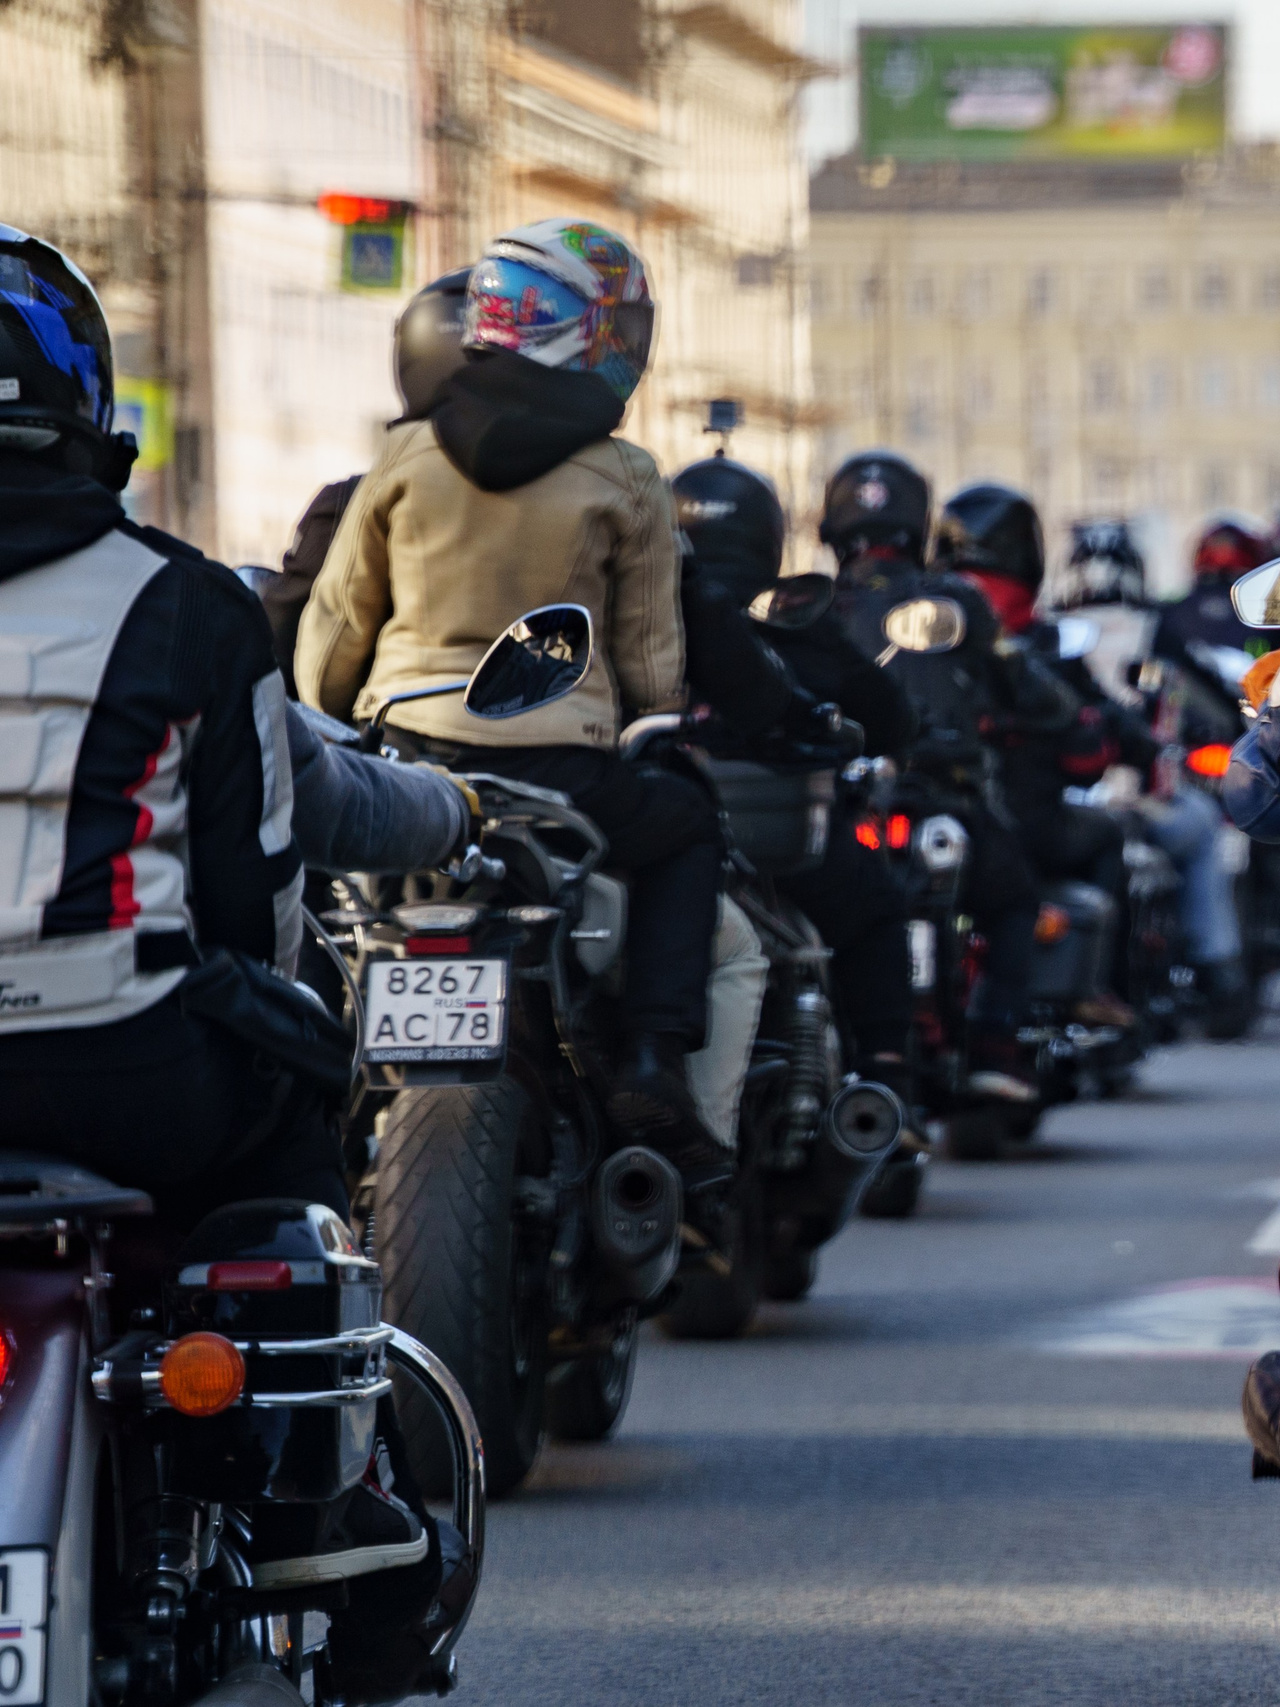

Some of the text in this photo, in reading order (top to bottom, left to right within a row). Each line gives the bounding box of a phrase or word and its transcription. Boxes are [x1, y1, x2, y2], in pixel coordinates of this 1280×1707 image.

[387, 965, 485, 995] 8267
[434, 998, 463, 1008] RUS
[374, 1012, 489, 1042] AC 78
